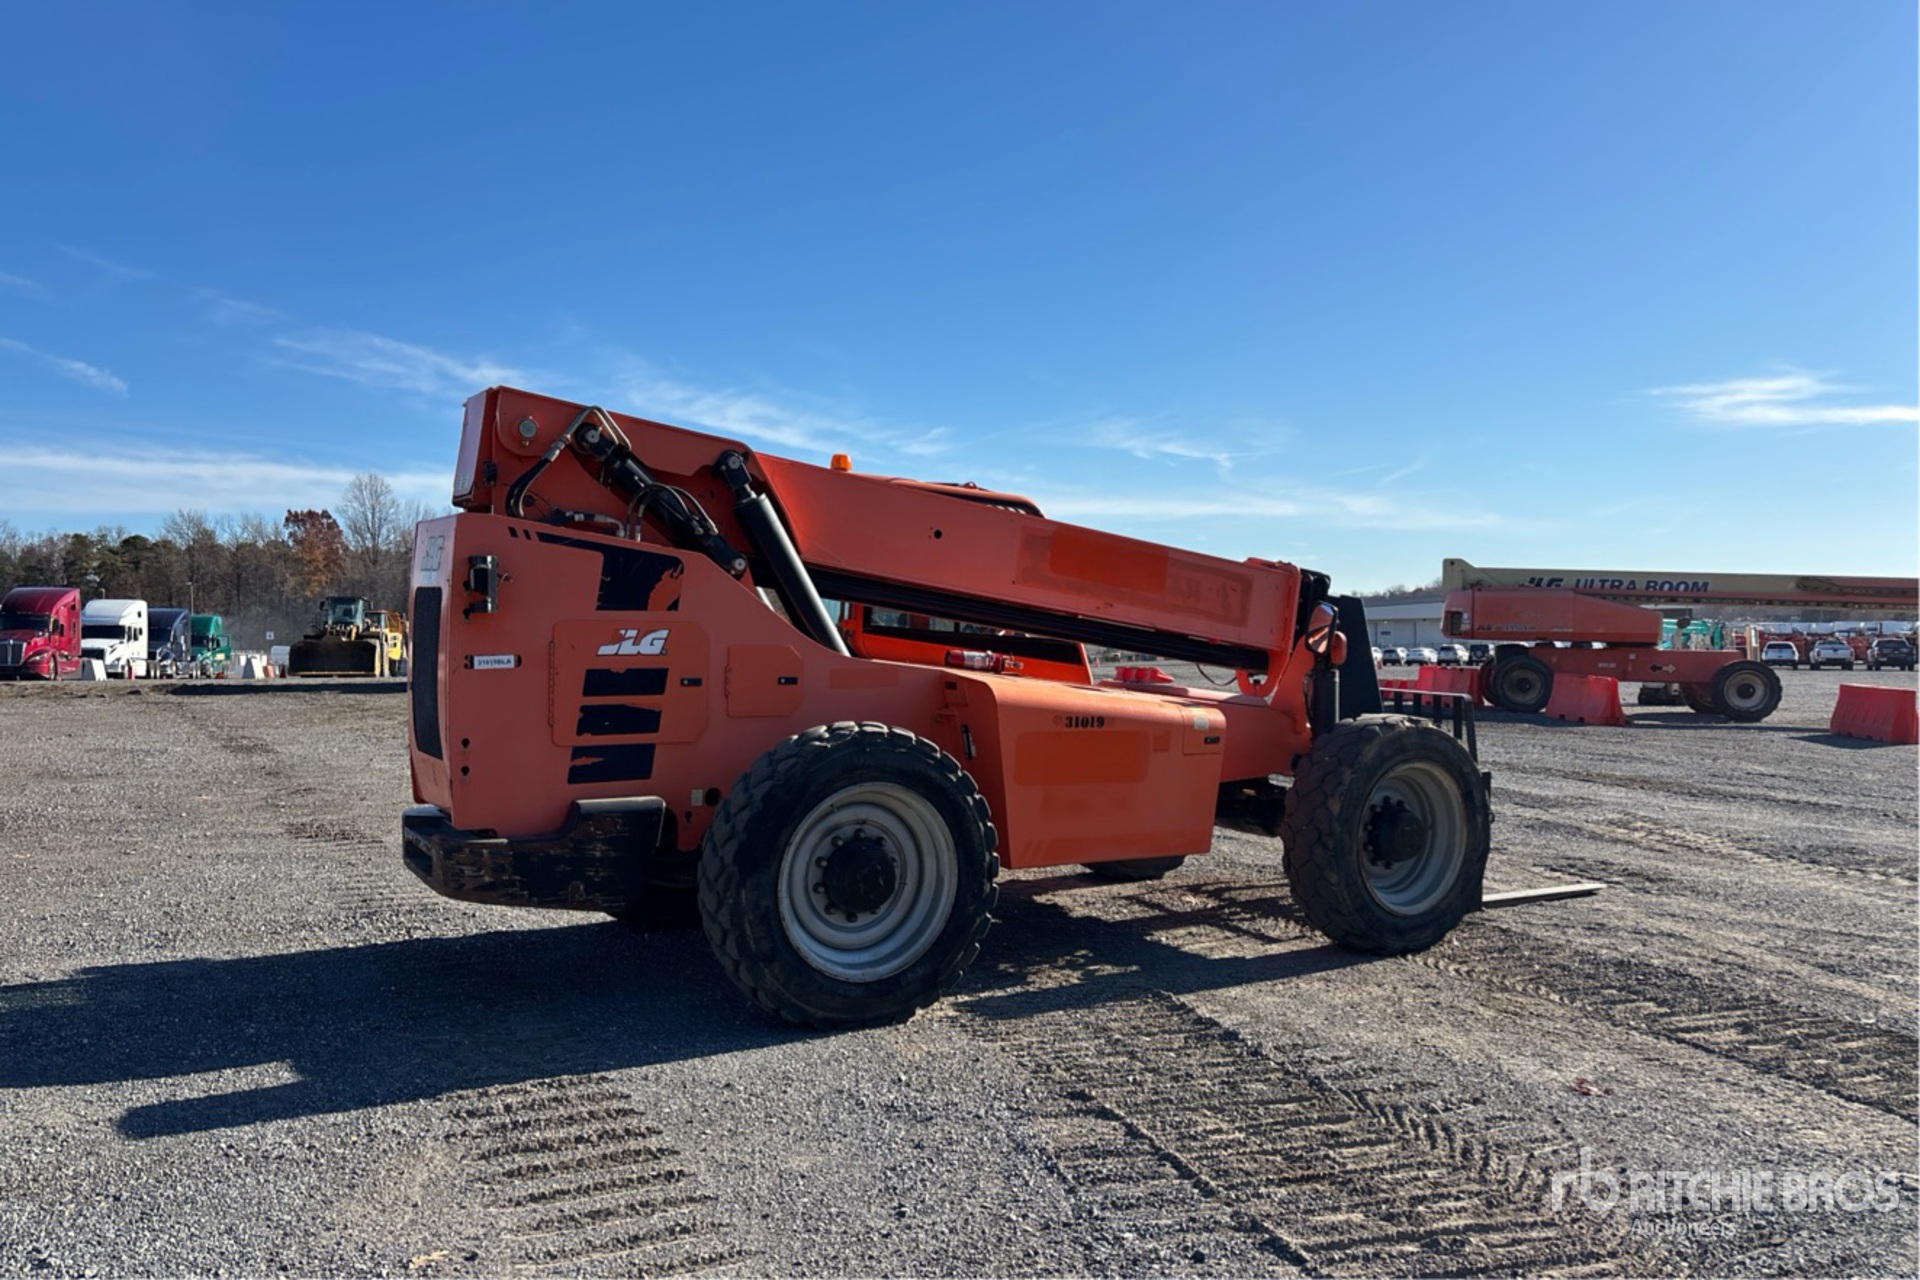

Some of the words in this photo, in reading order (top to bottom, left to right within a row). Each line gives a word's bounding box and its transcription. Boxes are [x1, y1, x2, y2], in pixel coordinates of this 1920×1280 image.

[1574, 578, 1637, 591] ULTRA
[1645, 580, 1710, 593] BOOM
[596, 628, 670, 656] JLG
[1065, 715, 1105, 729] 31019
